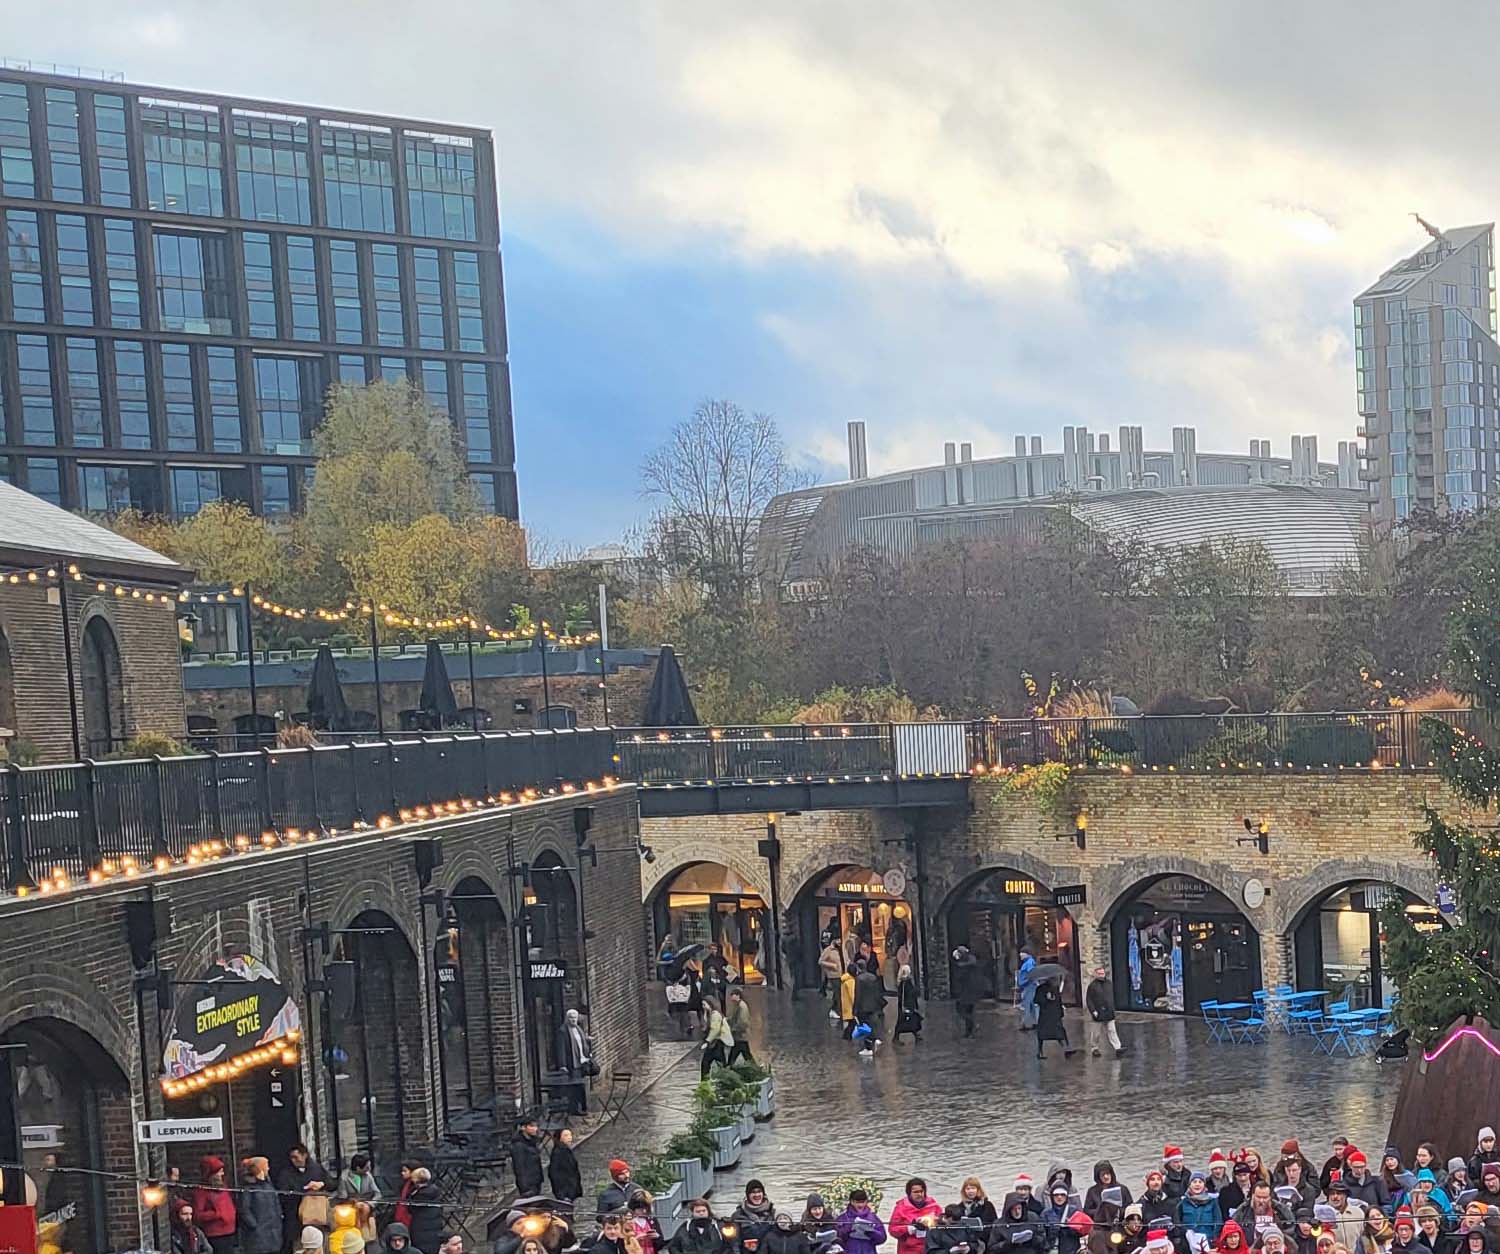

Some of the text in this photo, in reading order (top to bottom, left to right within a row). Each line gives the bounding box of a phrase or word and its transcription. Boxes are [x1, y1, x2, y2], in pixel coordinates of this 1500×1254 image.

[838, 883, 862, 893] ASTRID
[1005, 881, 1035, 894] CUBITTS
[196, 995, 259, 1034] EXTRAORDINARY
[236, 1013, 261, 1037] STYLE
[157, 1126, 213, 1136] LESTRANGE
